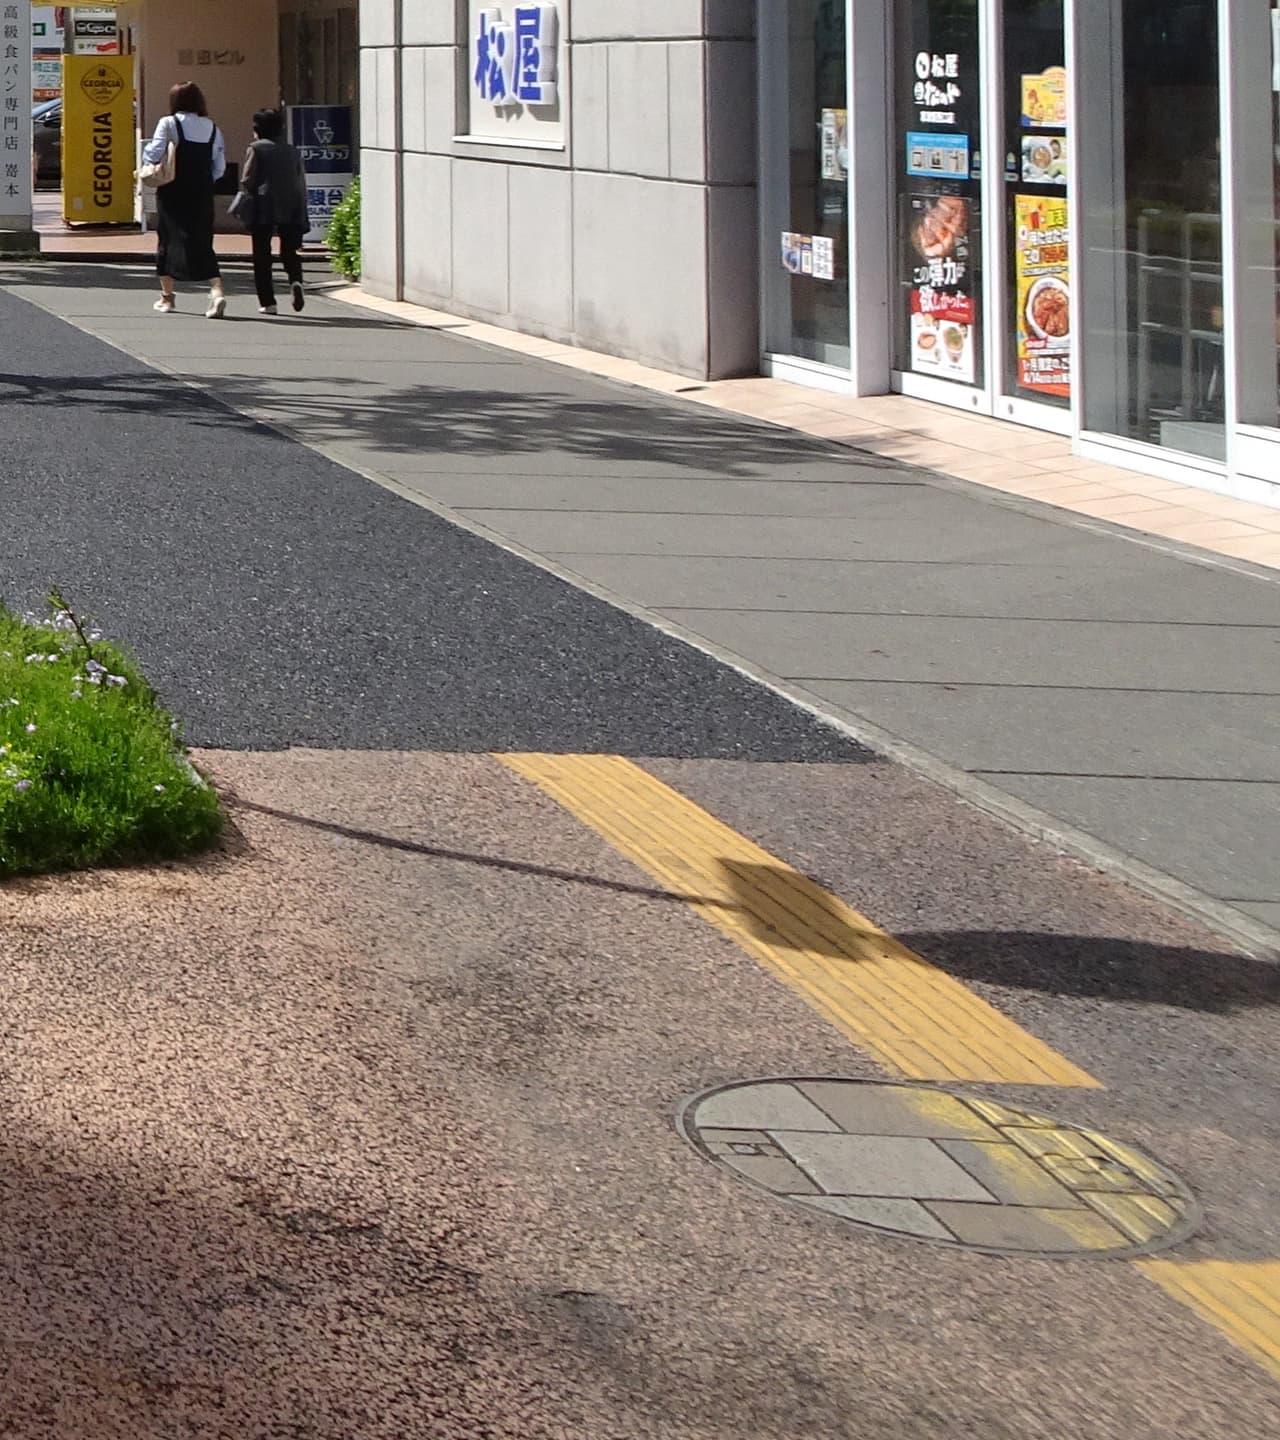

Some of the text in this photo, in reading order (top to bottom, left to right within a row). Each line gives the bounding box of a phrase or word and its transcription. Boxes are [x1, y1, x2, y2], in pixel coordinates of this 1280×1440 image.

[3, 4, 20, 152] 高級食パン専門店
[473, 6, 543, 104] 松屋
[93, 111, 113, 208] GEORGIA
